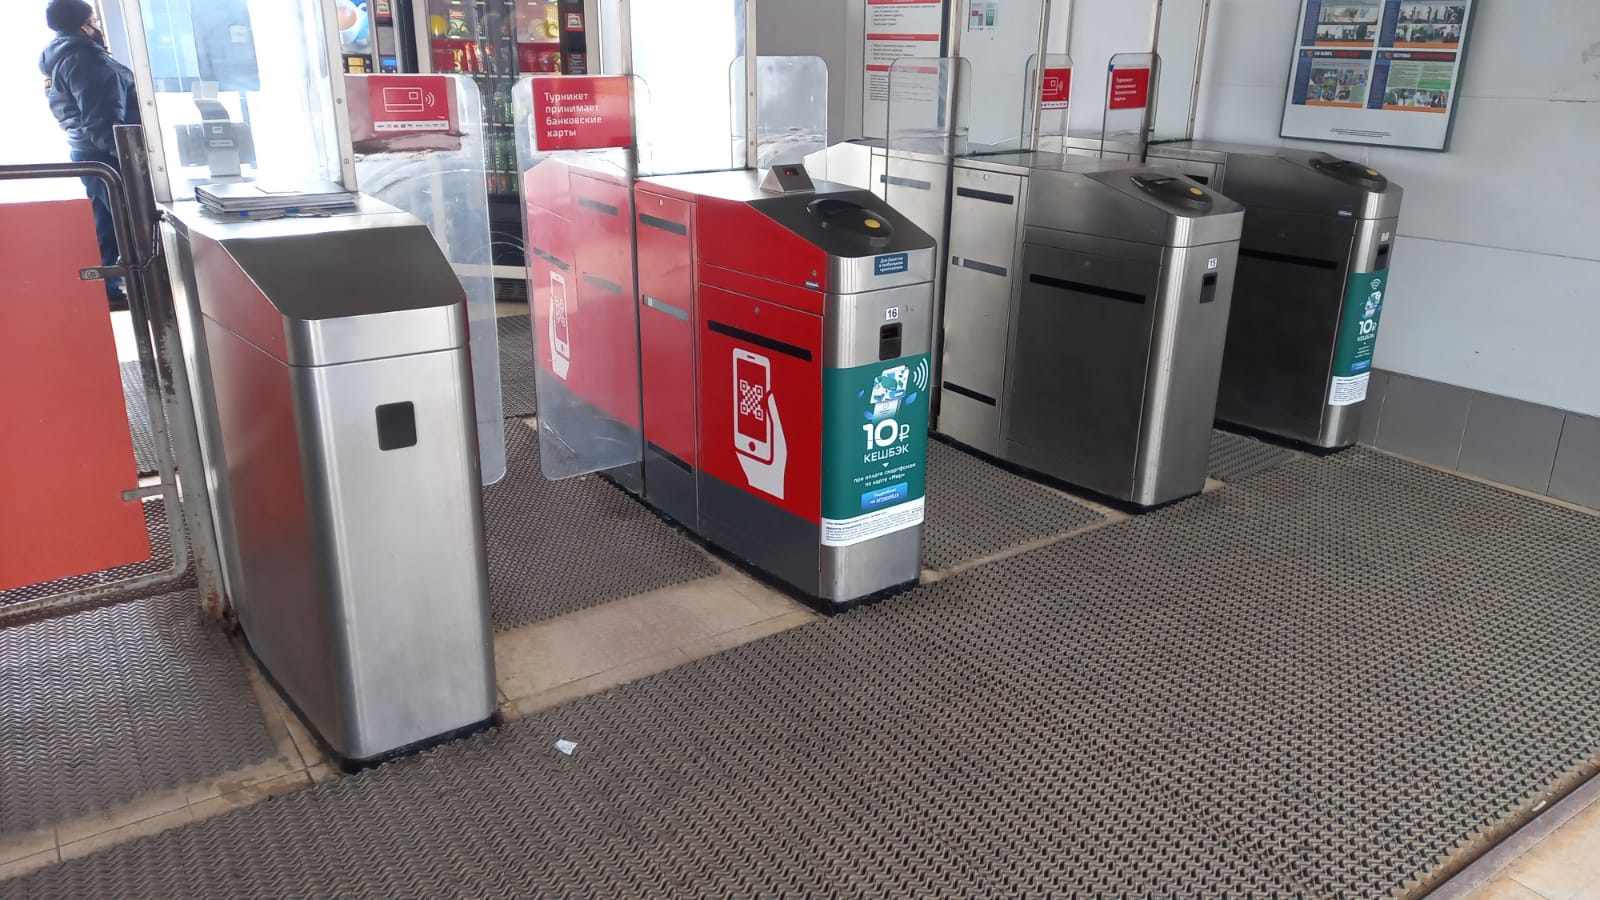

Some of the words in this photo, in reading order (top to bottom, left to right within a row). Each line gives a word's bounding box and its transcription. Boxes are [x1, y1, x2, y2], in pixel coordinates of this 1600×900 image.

[544, 92, 589, 103] Турникет
[545, 104, 600, 115] принимает
[546, 116, 602, 126] банковские
[547, 129, 577, 139] карты
[887, 308, 898, 319] 16
[863, 443, 910, 463] КЕШБЭК
[853, 476, 864, 484] при
[865, 471, 883, 480] оплате
[873, 477, 888, 485] карте
